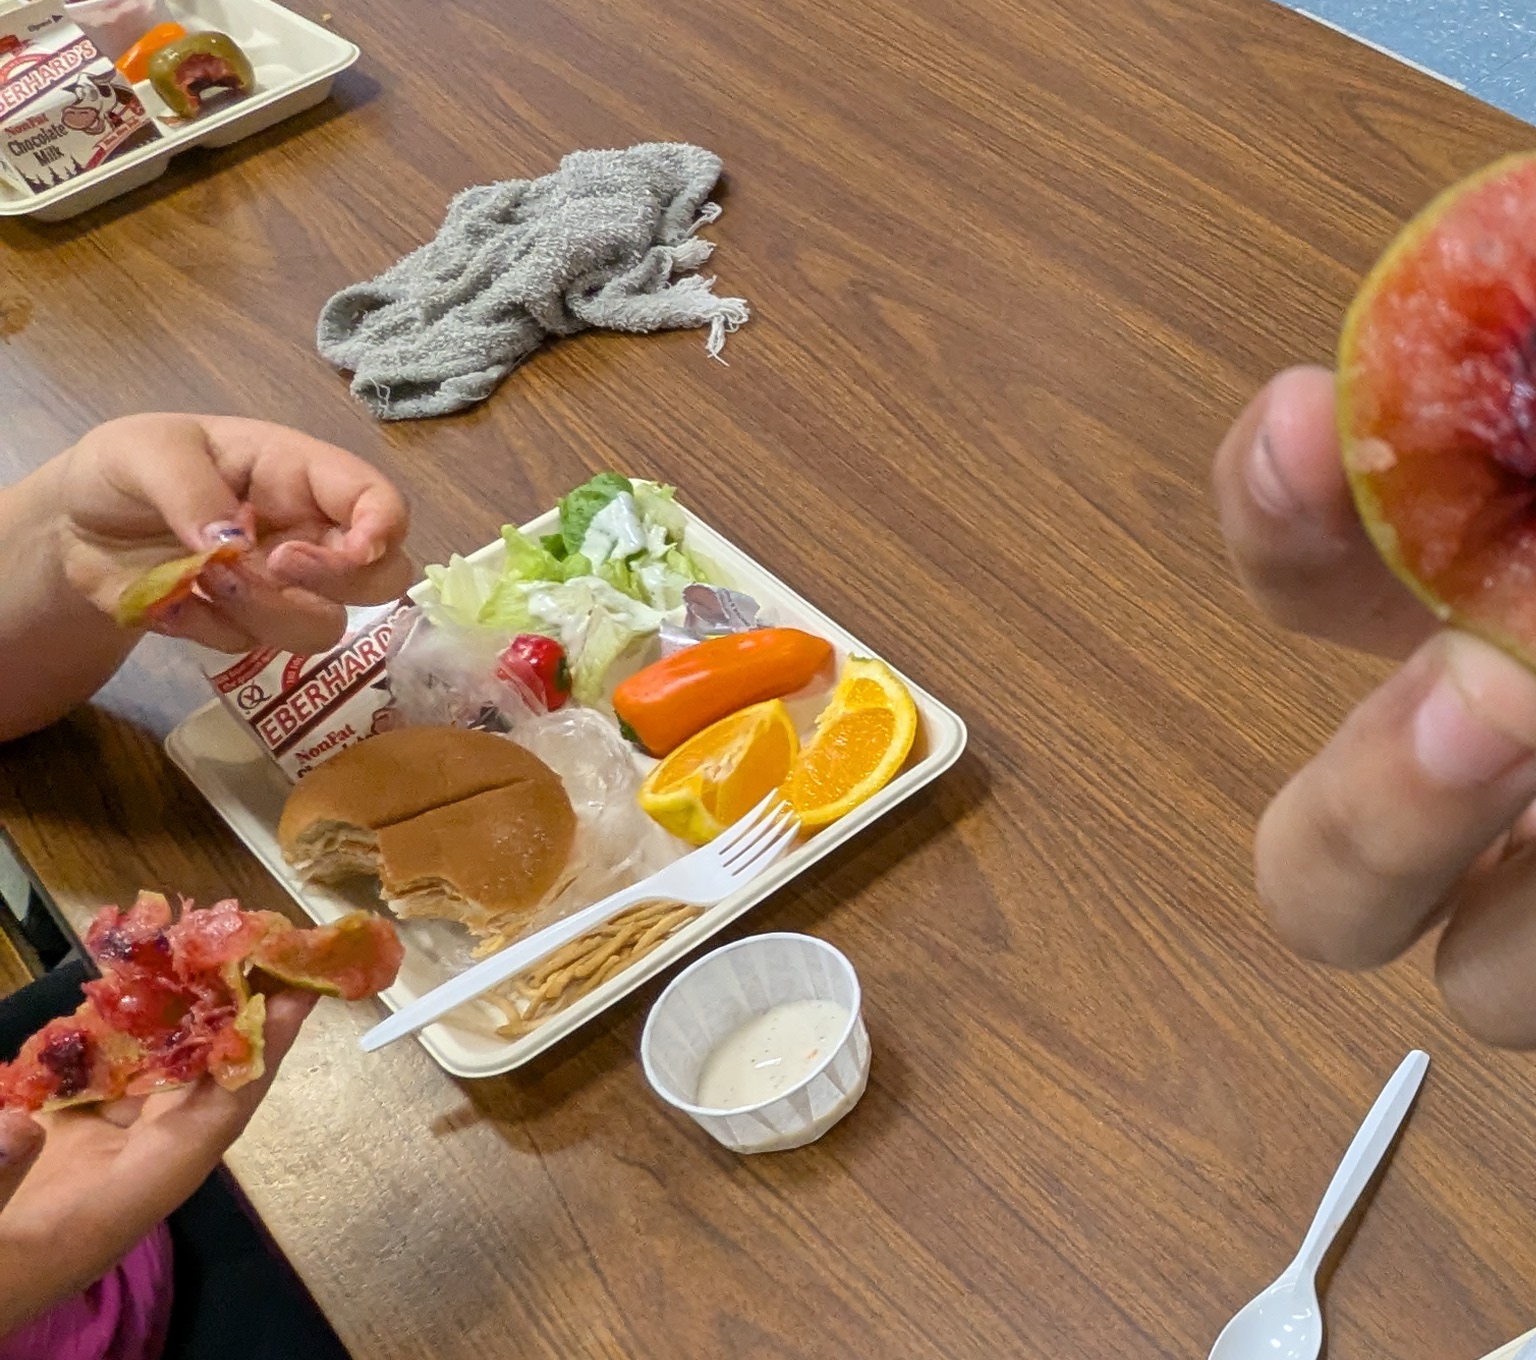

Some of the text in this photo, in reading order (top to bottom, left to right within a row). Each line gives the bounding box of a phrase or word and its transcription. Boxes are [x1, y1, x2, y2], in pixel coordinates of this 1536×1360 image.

[8, 122, 70, 156] Chocolate
[33, 144, 65, 167] Milk
[259, 607, 410, 747] EBERHARD
[295, 723, 356, 764] NonFat
